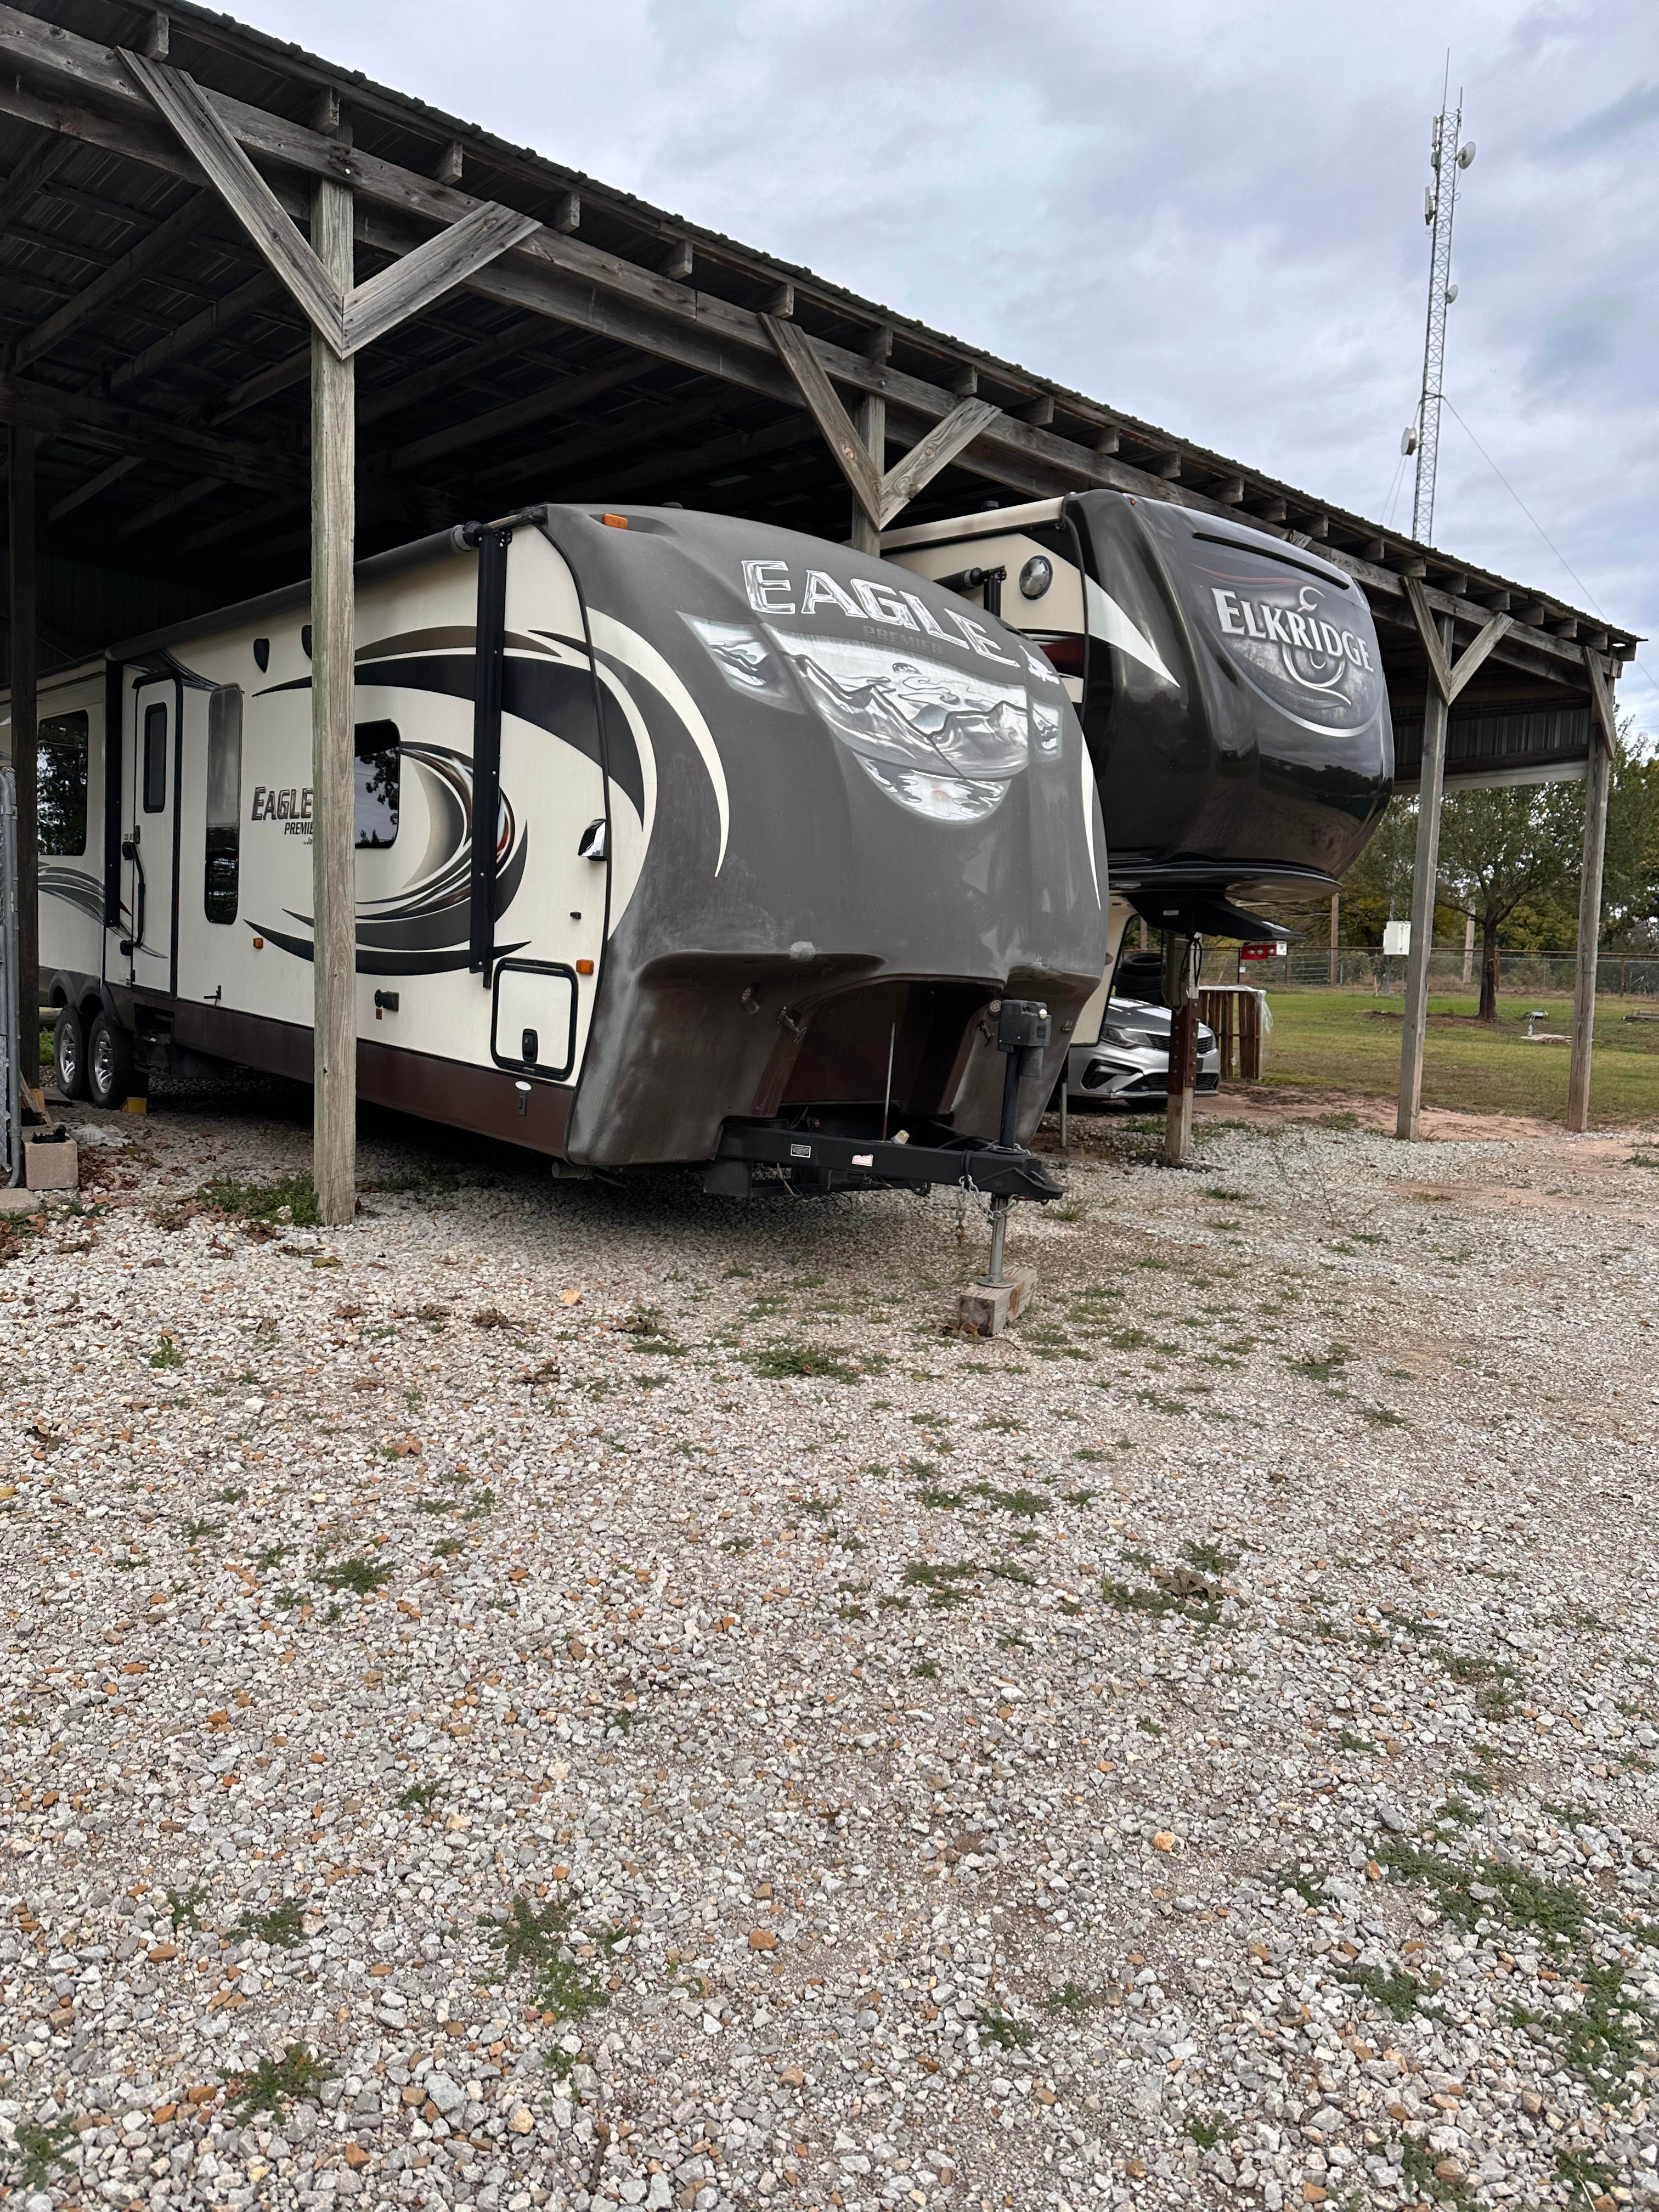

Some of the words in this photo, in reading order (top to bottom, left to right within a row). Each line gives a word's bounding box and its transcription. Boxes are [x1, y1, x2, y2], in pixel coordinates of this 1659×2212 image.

[741, 560, 1020, 667] EAGLE
[1211, 587, 1374, 673] ELKRIDGE
[862, 625, 944, 656] PREMIER
[251, 786, 313, 821] EAGLE
[284, 821, 313, 835] PREMIE
